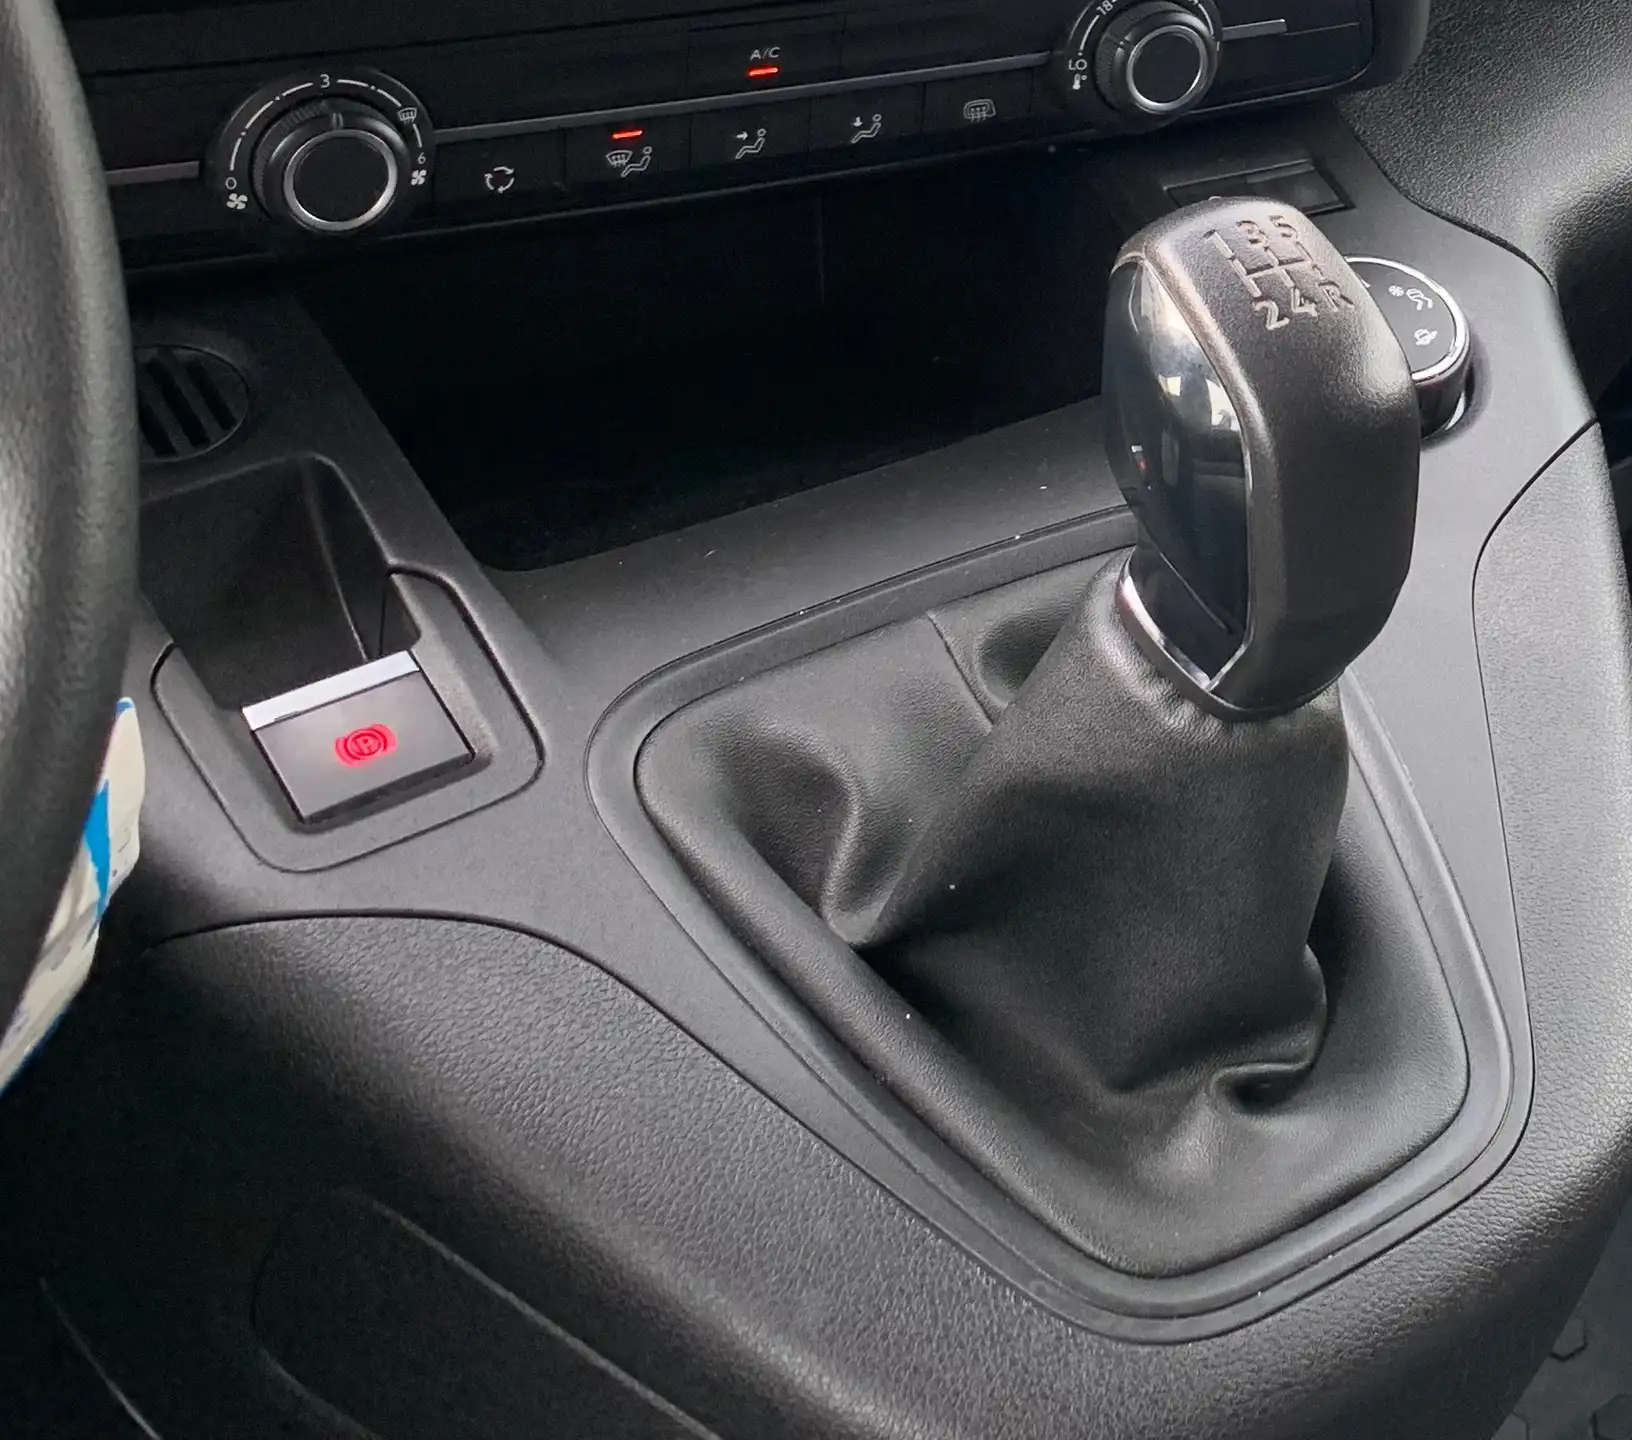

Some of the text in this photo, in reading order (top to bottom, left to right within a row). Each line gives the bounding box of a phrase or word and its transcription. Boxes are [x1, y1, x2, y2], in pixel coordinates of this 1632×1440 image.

[1096, 0, 1114, 16] 18
[750, 46, 781, 60] A/C
[1068, 58, 1088, 71] LO
[319, 74, 331, 89] 3
[417, 152, 427, 165] 6
[1235, 220, 1270, 247] 3
[1268, 215, 1300, 240] 5
[1251, 296, 1291, 331] 2
[1290, 287, 1319, 317] 4
